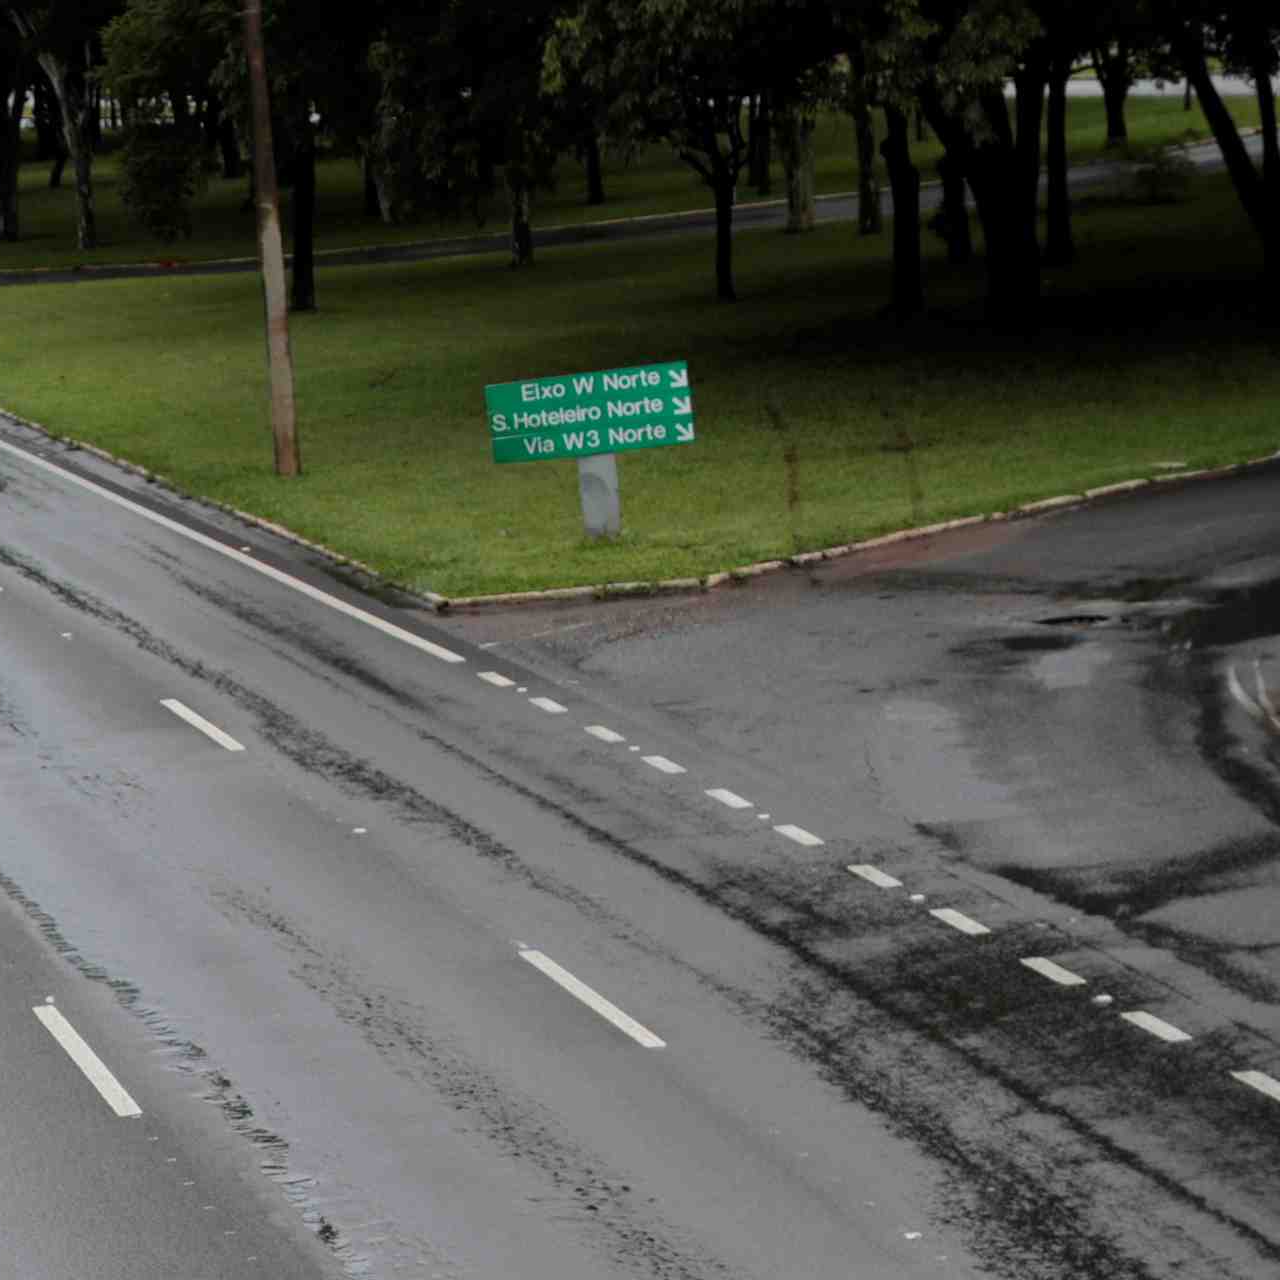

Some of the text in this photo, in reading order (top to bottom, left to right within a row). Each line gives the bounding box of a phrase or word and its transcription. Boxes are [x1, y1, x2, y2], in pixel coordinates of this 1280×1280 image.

[521, 370, 661, 402] Eixo W Norte
[607, 397, 664, 419] Norte
[523, 424, 666, 455] Via W3 Norte
